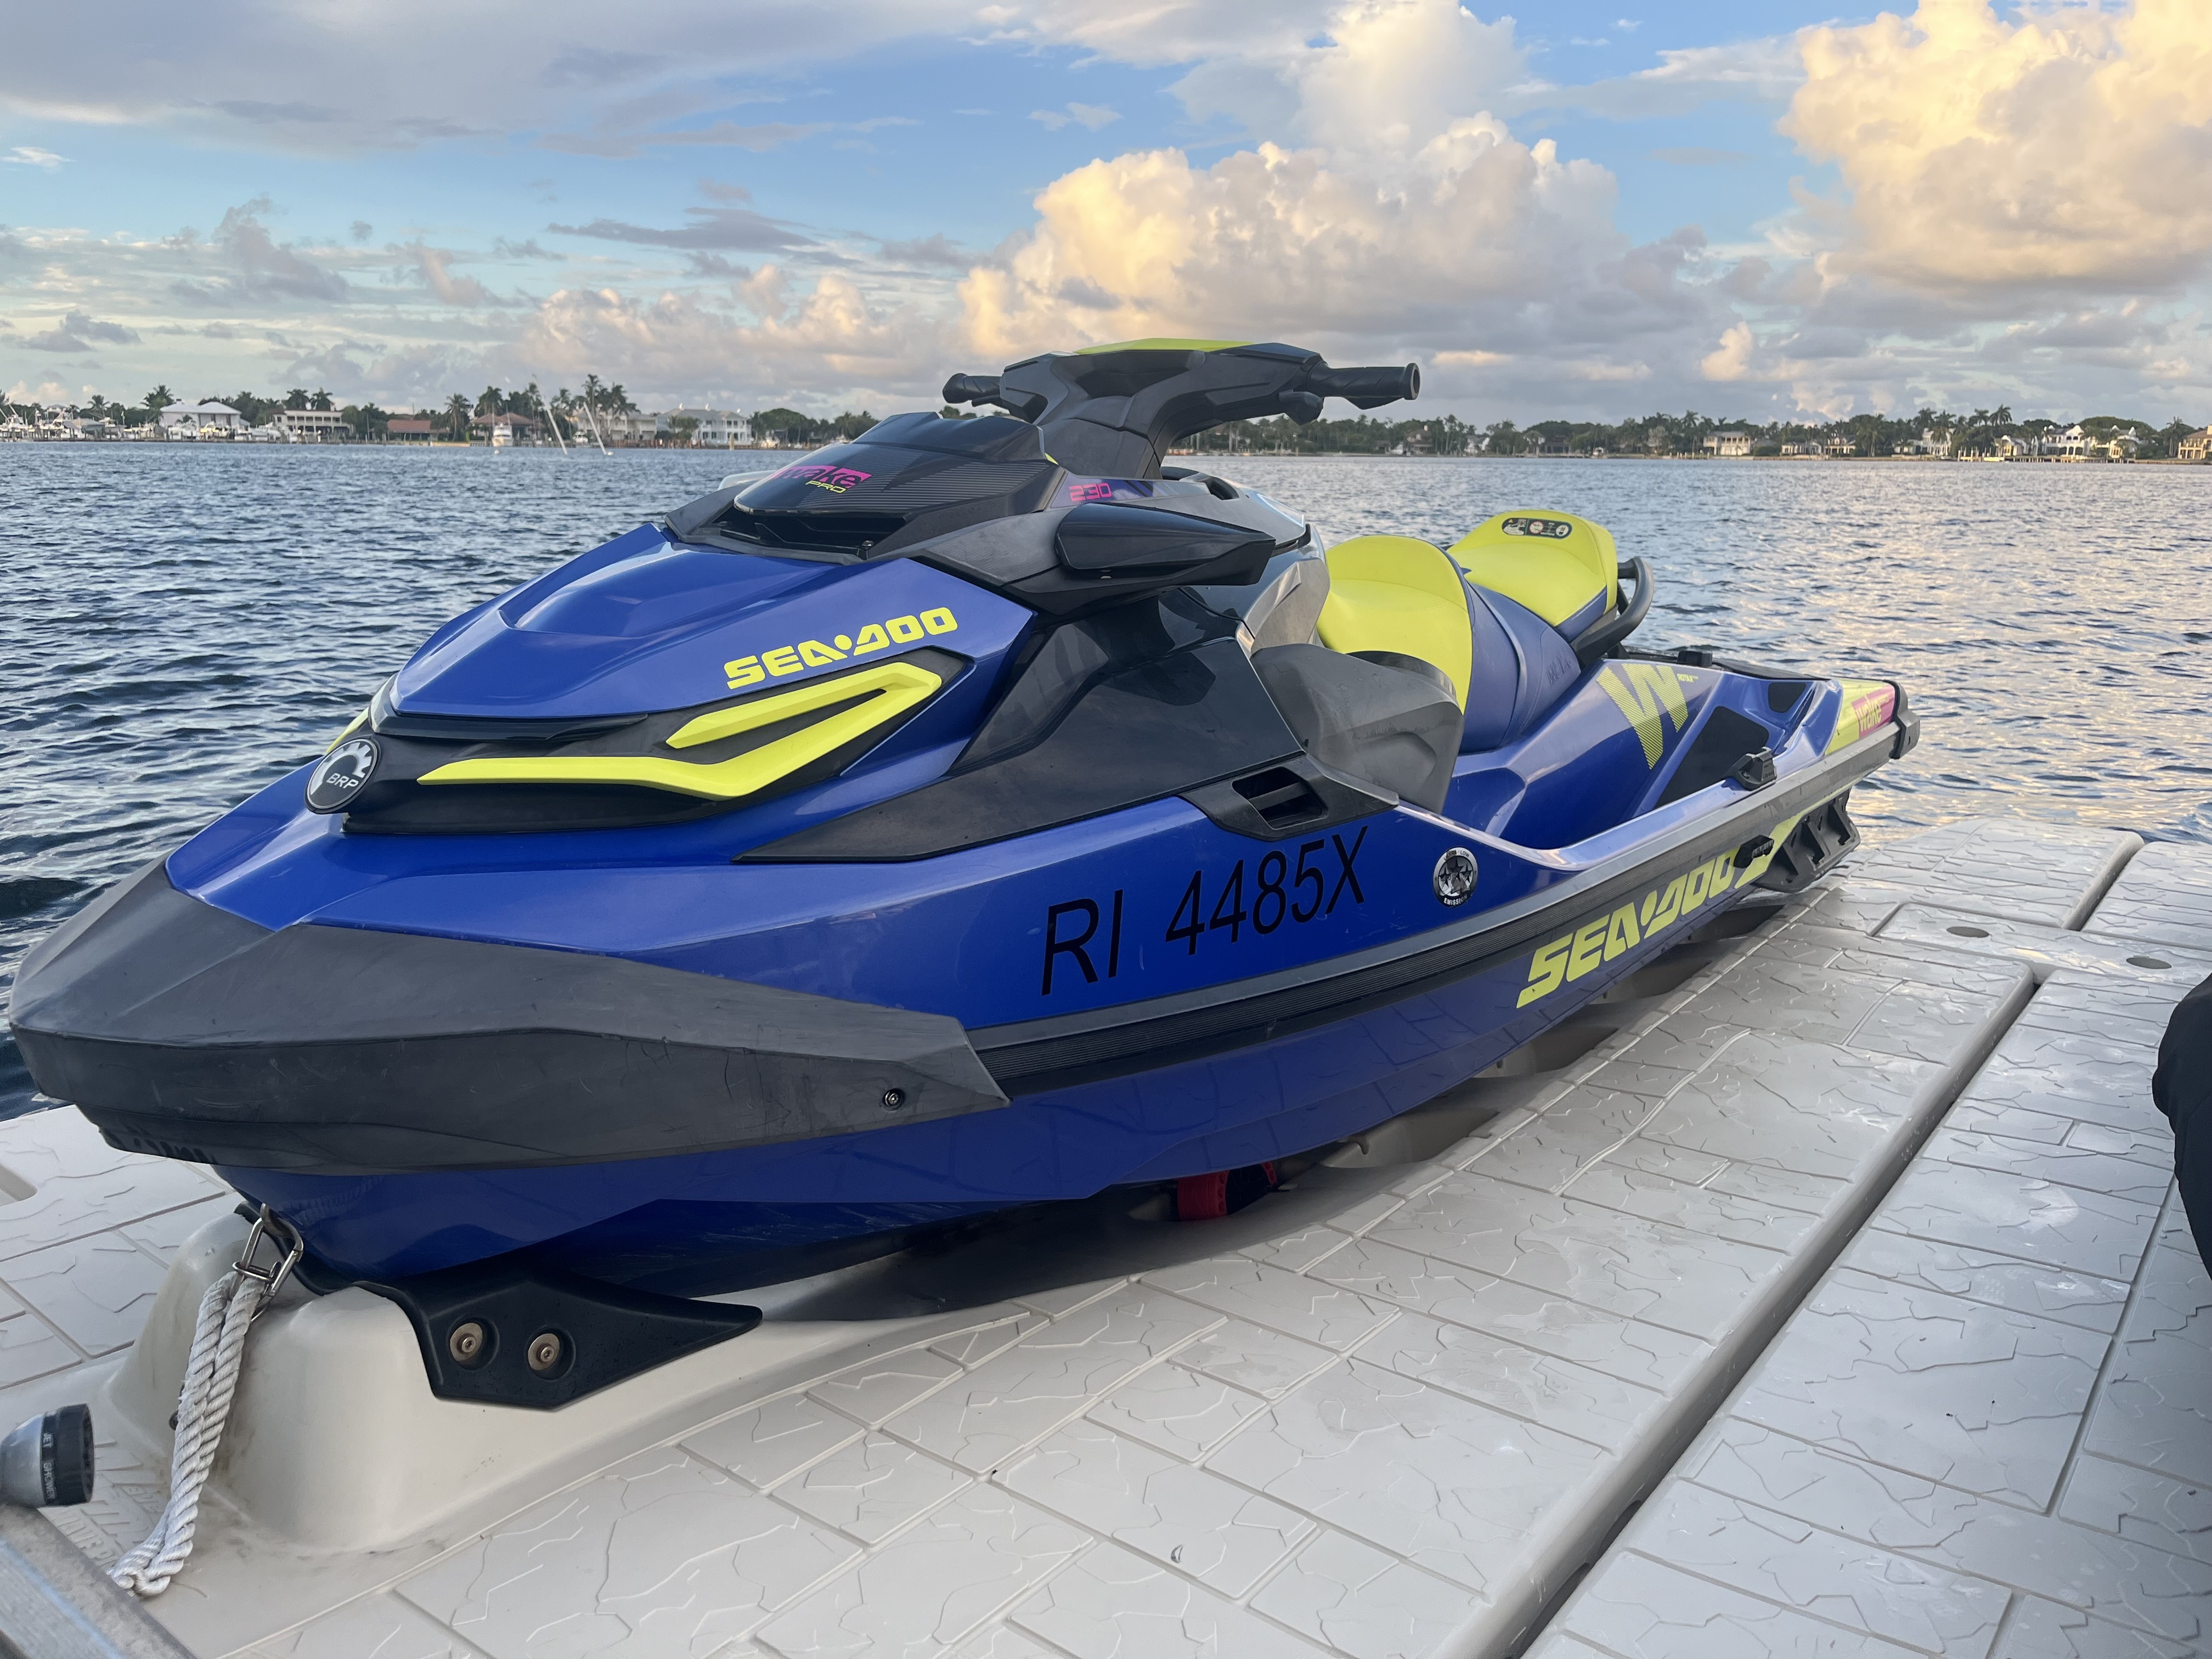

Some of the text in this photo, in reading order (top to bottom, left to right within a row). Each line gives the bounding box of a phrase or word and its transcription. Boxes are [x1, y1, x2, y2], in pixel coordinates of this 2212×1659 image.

[805, 481, 846, 493] PRO
[1069, 483, 1112, 501] 230
[326, 772, 359, 789] BRP
[1443, 894, 1468, 906] EMISSION
[1041, 825, 1368, 996] RI 4485X
